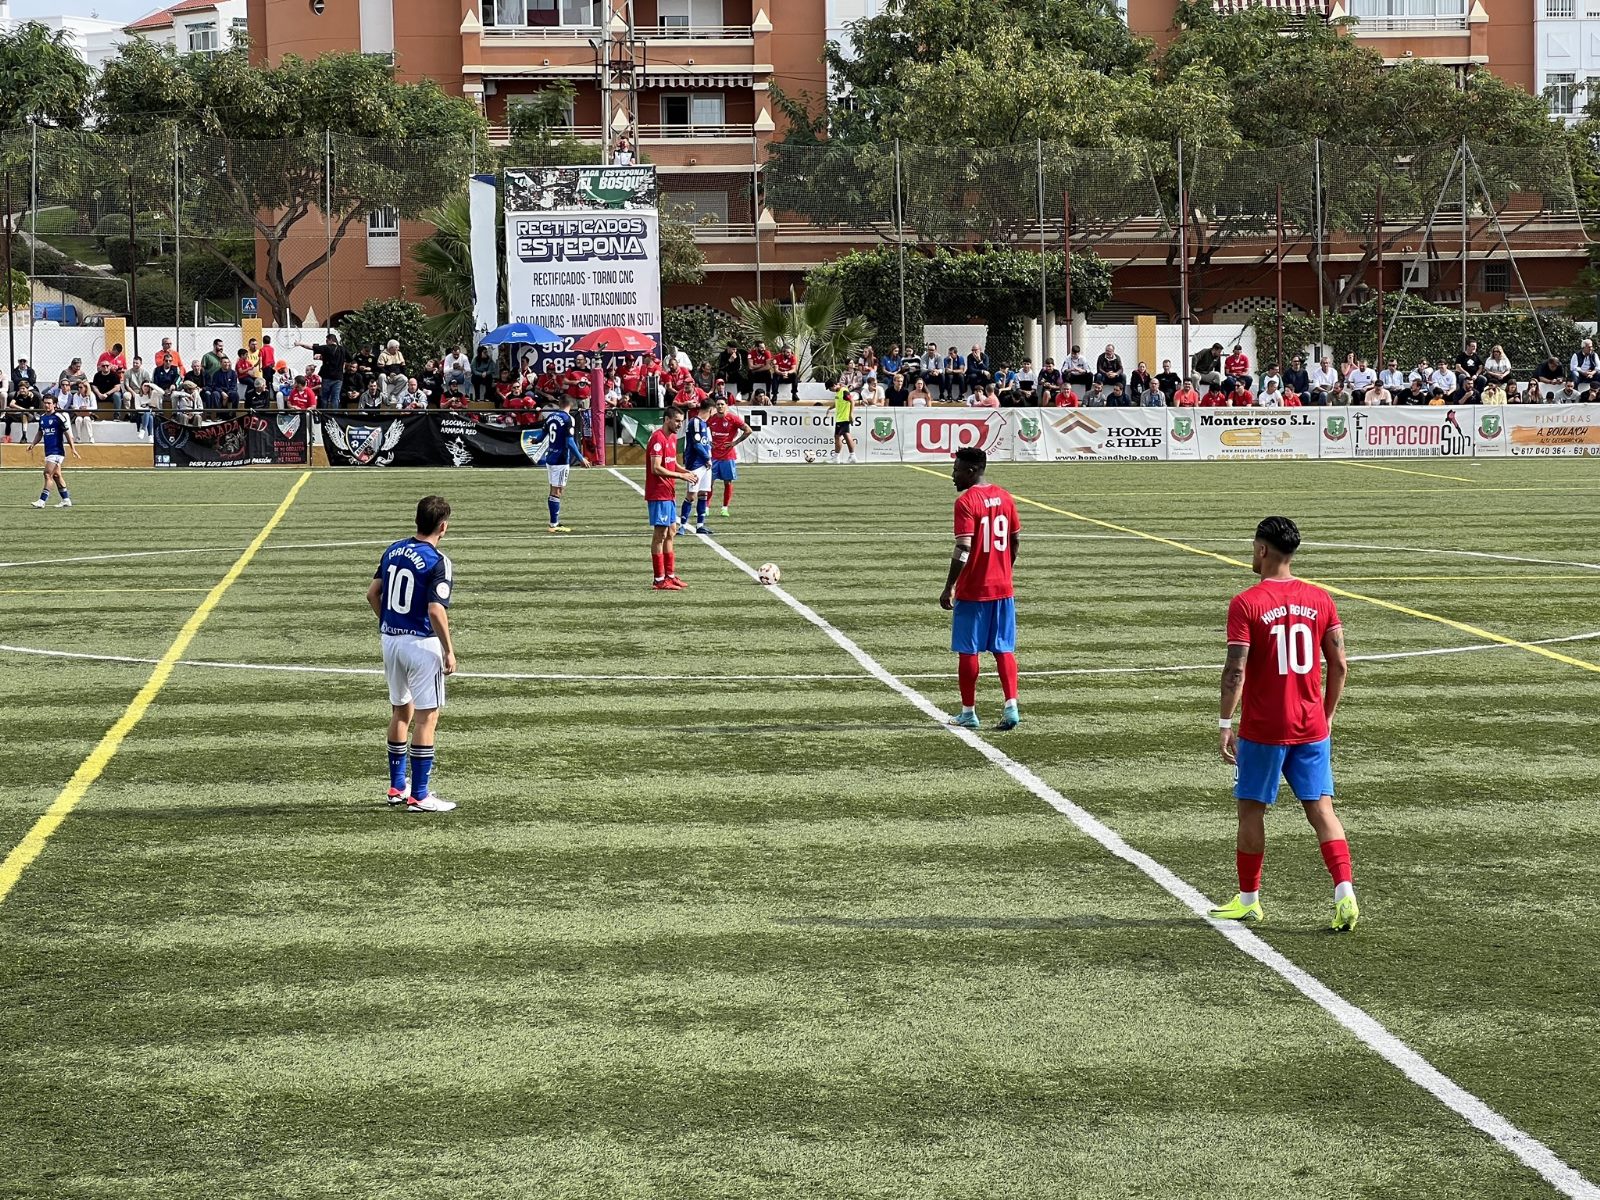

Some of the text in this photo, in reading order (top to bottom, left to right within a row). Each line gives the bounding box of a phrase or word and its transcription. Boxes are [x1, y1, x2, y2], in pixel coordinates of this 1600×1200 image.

[517, 219, 646, 239] RECTIFICADOS
[517, 236, 647, 262] ESTEPONA
[533, 272, 585, 286] RECTIFICADOS
[592, 271, 617, 284] TORNO
[618, 270, 634, 284] CNC
[531, 293, 575, 307] FRESADORA
[582, 292, 637, 306] ULTRASONIDOS
[571, 314, 626, 328] MANDRINADOS
[627, 314, 635, 327] IN
[636, 313, 654, 326] SITU
[194, 420, 240, 440] ARMADA
[243, 416, 268, 432] RED
[771, 416, 862, 427] PROICOCIS
[1200, 415, 1316, 426] Monterroso S.L.
[1535, 415, 1592, 424] PINTURAS
[549, 422, 557, 443] 6
[1107, 428, 1162, 437] HOME
[1117, 439, 1161, 448] HELP
[981, 514, 1008, 553] 19
[404, 548, 426, 570] CANO
[387, 564, 415, 614] 10
[1261, 605, 1287, 625] HUGO
[1270, 623, 1313, 675] 10
